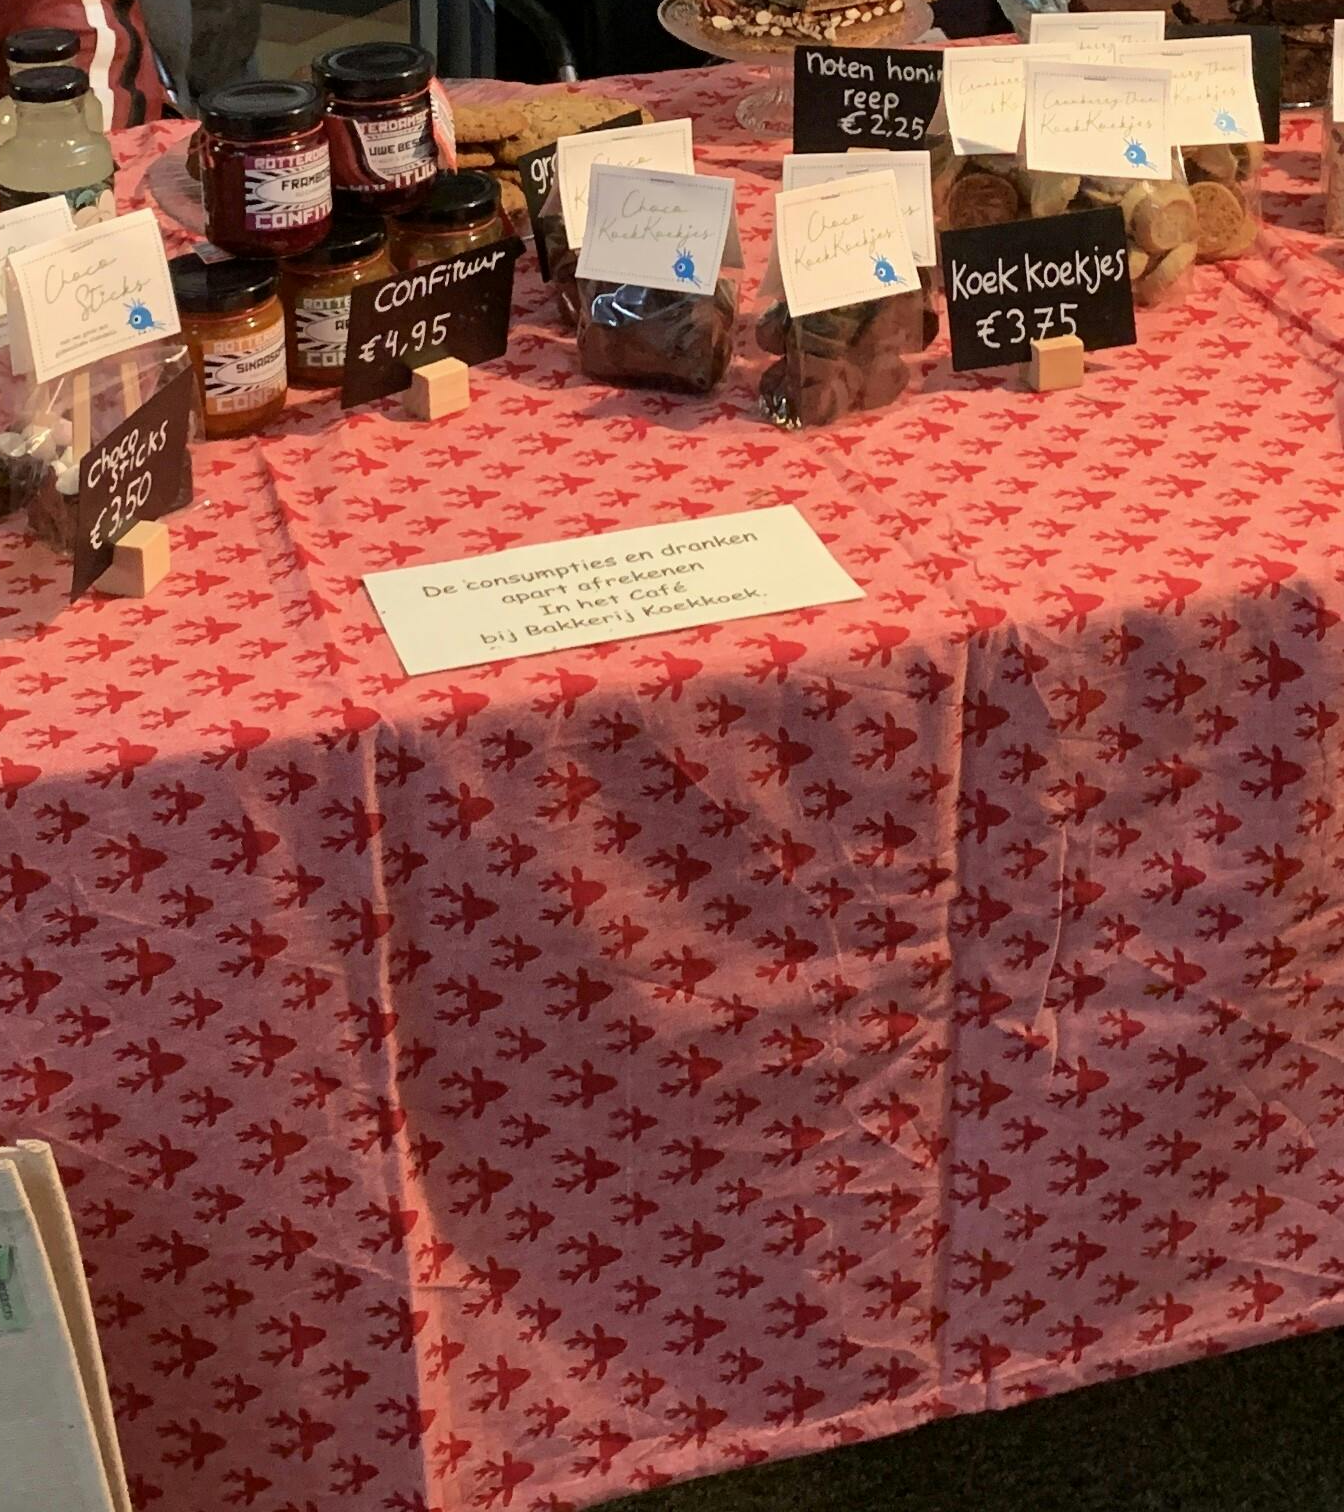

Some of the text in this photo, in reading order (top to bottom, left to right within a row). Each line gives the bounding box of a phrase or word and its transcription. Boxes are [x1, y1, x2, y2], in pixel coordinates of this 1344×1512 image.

[843, 88, 900, 120] reep
[621, 190, 690, 219] Choco
[808, 210, 865, 241] Choco
[44, 254, 119, 305] Choco
[75, 275, 152, 322] Sticks
[422, 527, 760, 600] De consumpties en dranken
[501, 559, 706, 607] apart afrekenen
[540, 580, 689, 619] In het Café
[479, 623, 519, 647] bij
[525, 606, 637, 639] Bakkerij
